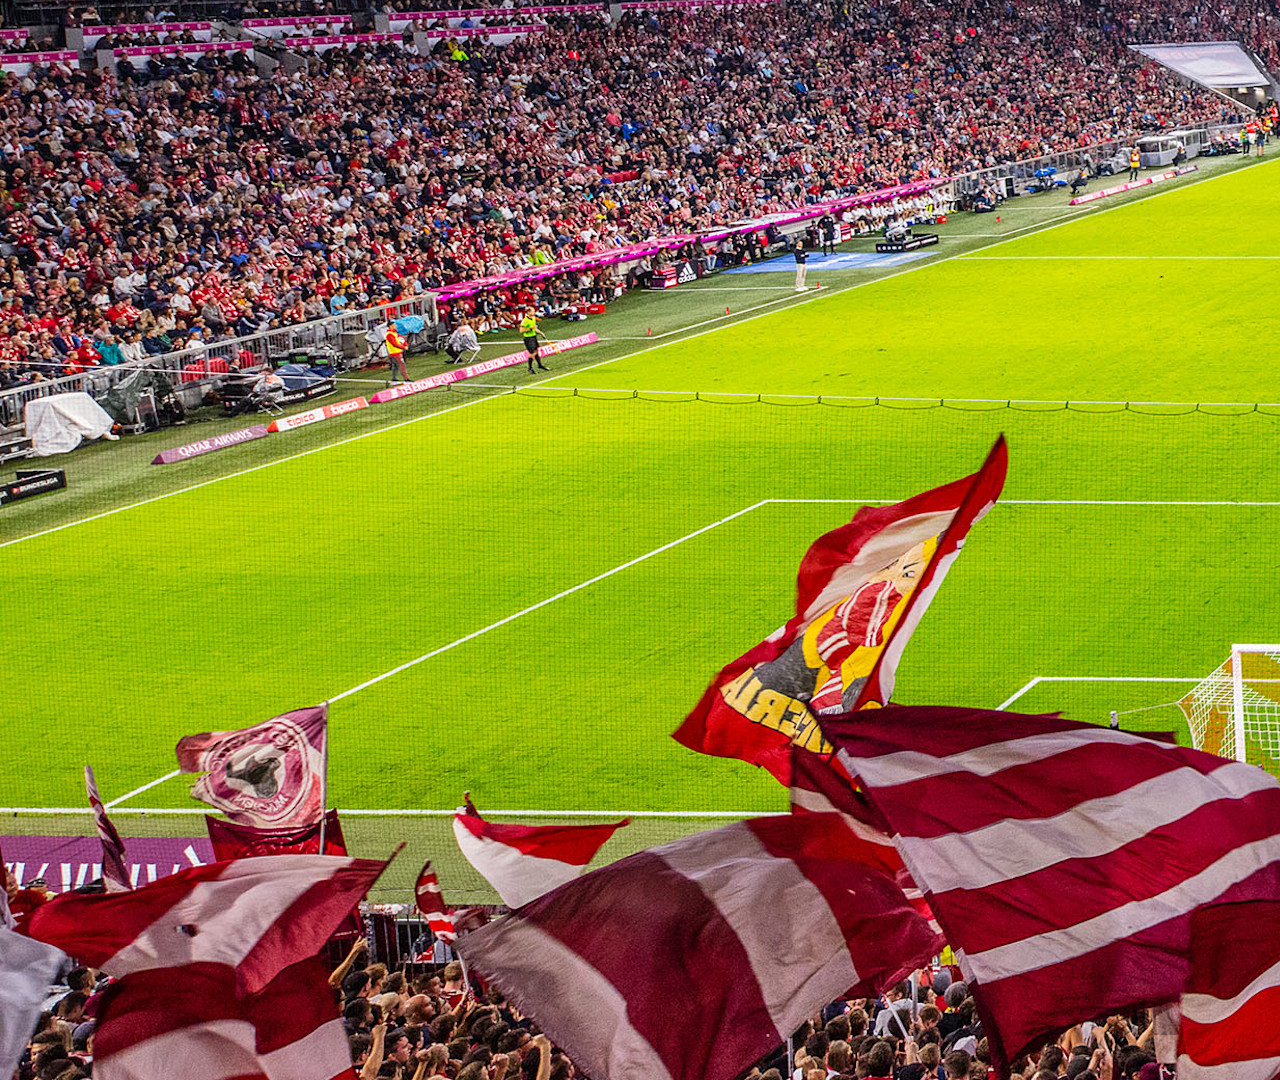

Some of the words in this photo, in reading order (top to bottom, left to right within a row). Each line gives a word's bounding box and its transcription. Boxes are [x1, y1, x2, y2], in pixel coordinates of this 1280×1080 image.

[678, 273, 697, 284] adidas
[475, 358, 505, 376] TELEKOM
[505, 352, 526, 367] SPORT
[401, 377, 434, 395] TELEKOM
[433, 371, 458, 386] SPORT
[330, 400, 359, 417] tipico
[286, 412, 316, 428] tipico
[179, 440, 213, 457] QATAR
[213, 428, 253, 448] AIRWAYS
